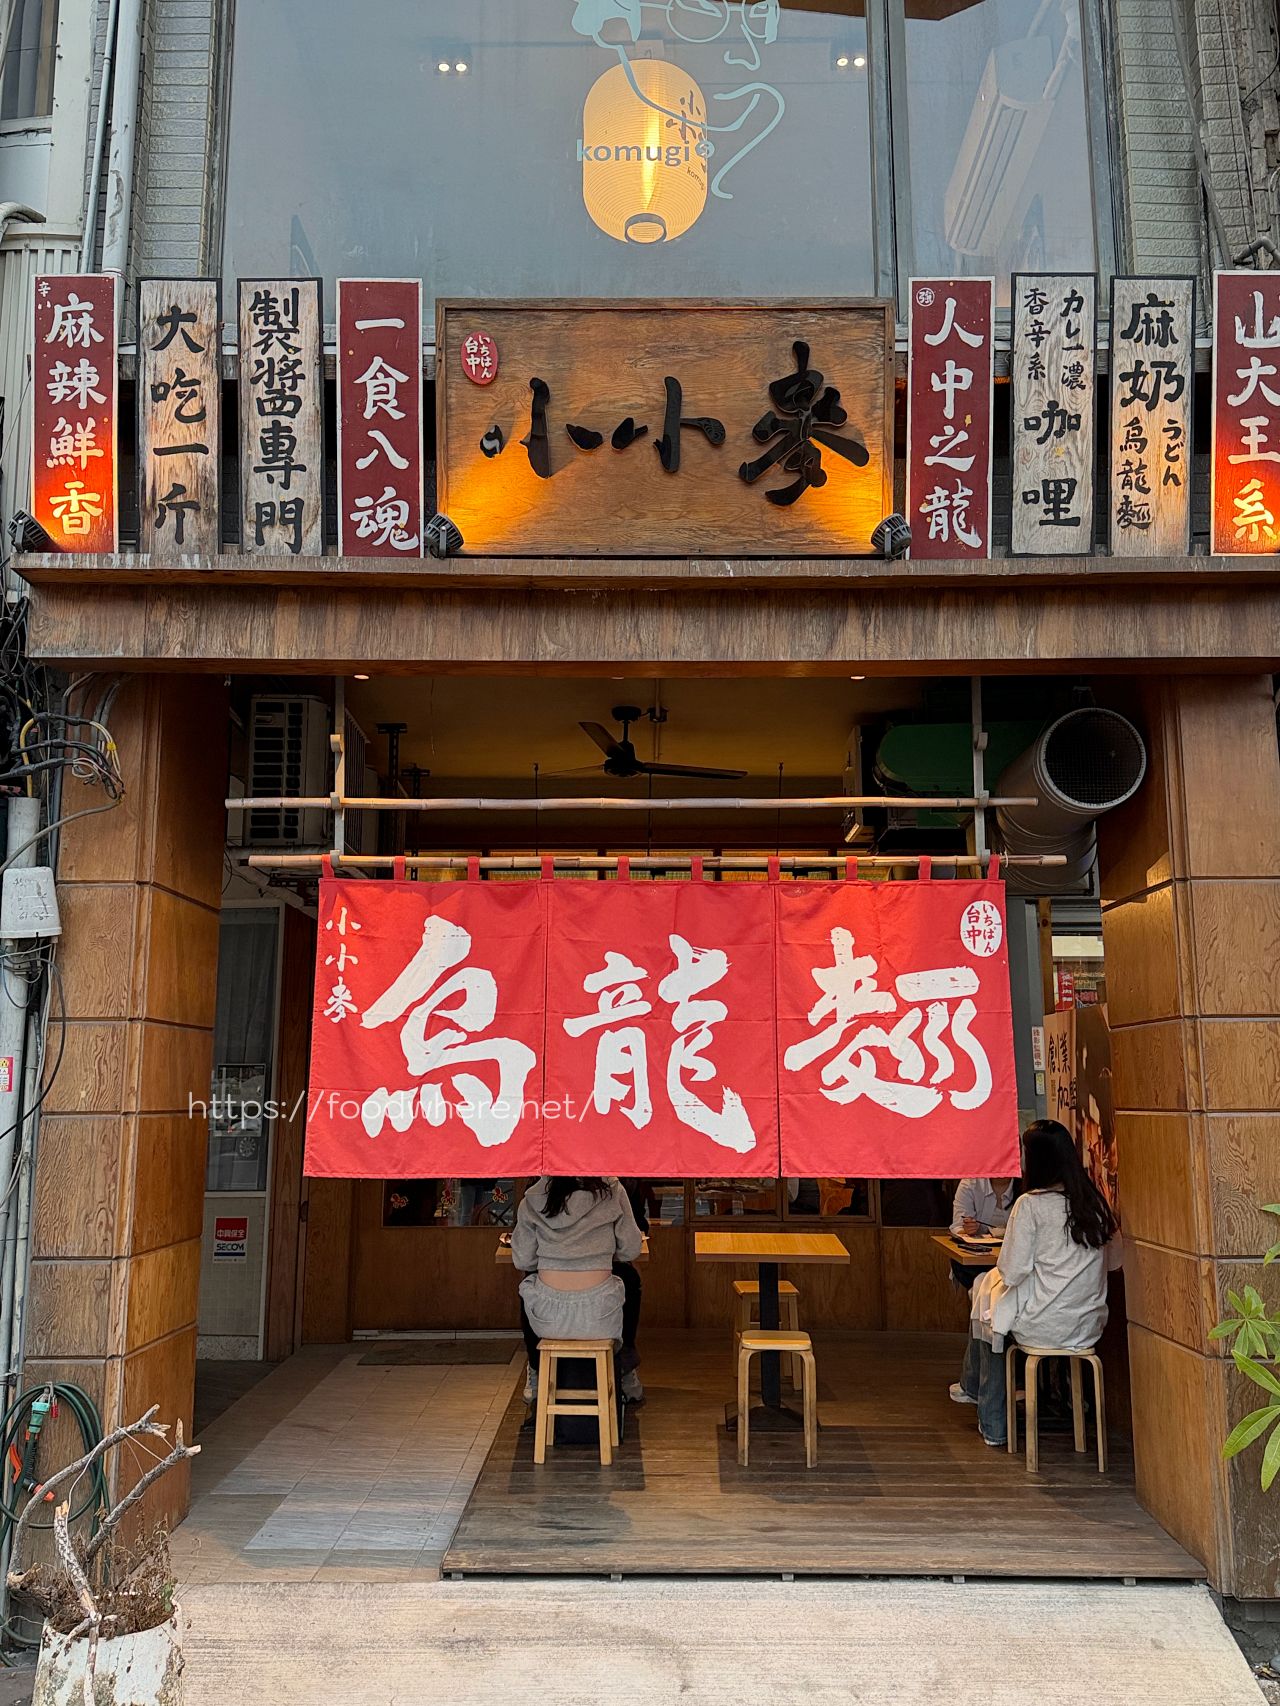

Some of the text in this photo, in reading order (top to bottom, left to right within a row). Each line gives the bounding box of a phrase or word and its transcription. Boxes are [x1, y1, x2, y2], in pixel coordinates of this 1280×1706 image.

[577, 139, 690, 166] komugi
[465, 336, 480, 376] 台中
[1024, 287, 1051, 380] 香辛系
[1118, 293, 1184, 411] 麻奶
[46, 292, 107, 535] 麻辣鮮香
[150, 305, 209, 545] 大吃一斤
[350, 317, 419, 550] 一食入魂
[480, 340, 869, 506] 小小麥
[919, 297, 984, 548] 人中之龍
[1022, 400, 1081, 527] 咖哩
[1162, 419, 1184, 486] うどん
[1227, 290, 1280, 543] 山大王系
[323, 907, 361, 1023] 小小麥
[967, 905, 981, 950] 台中
[216, 1243, 244, 1251] SECOM
